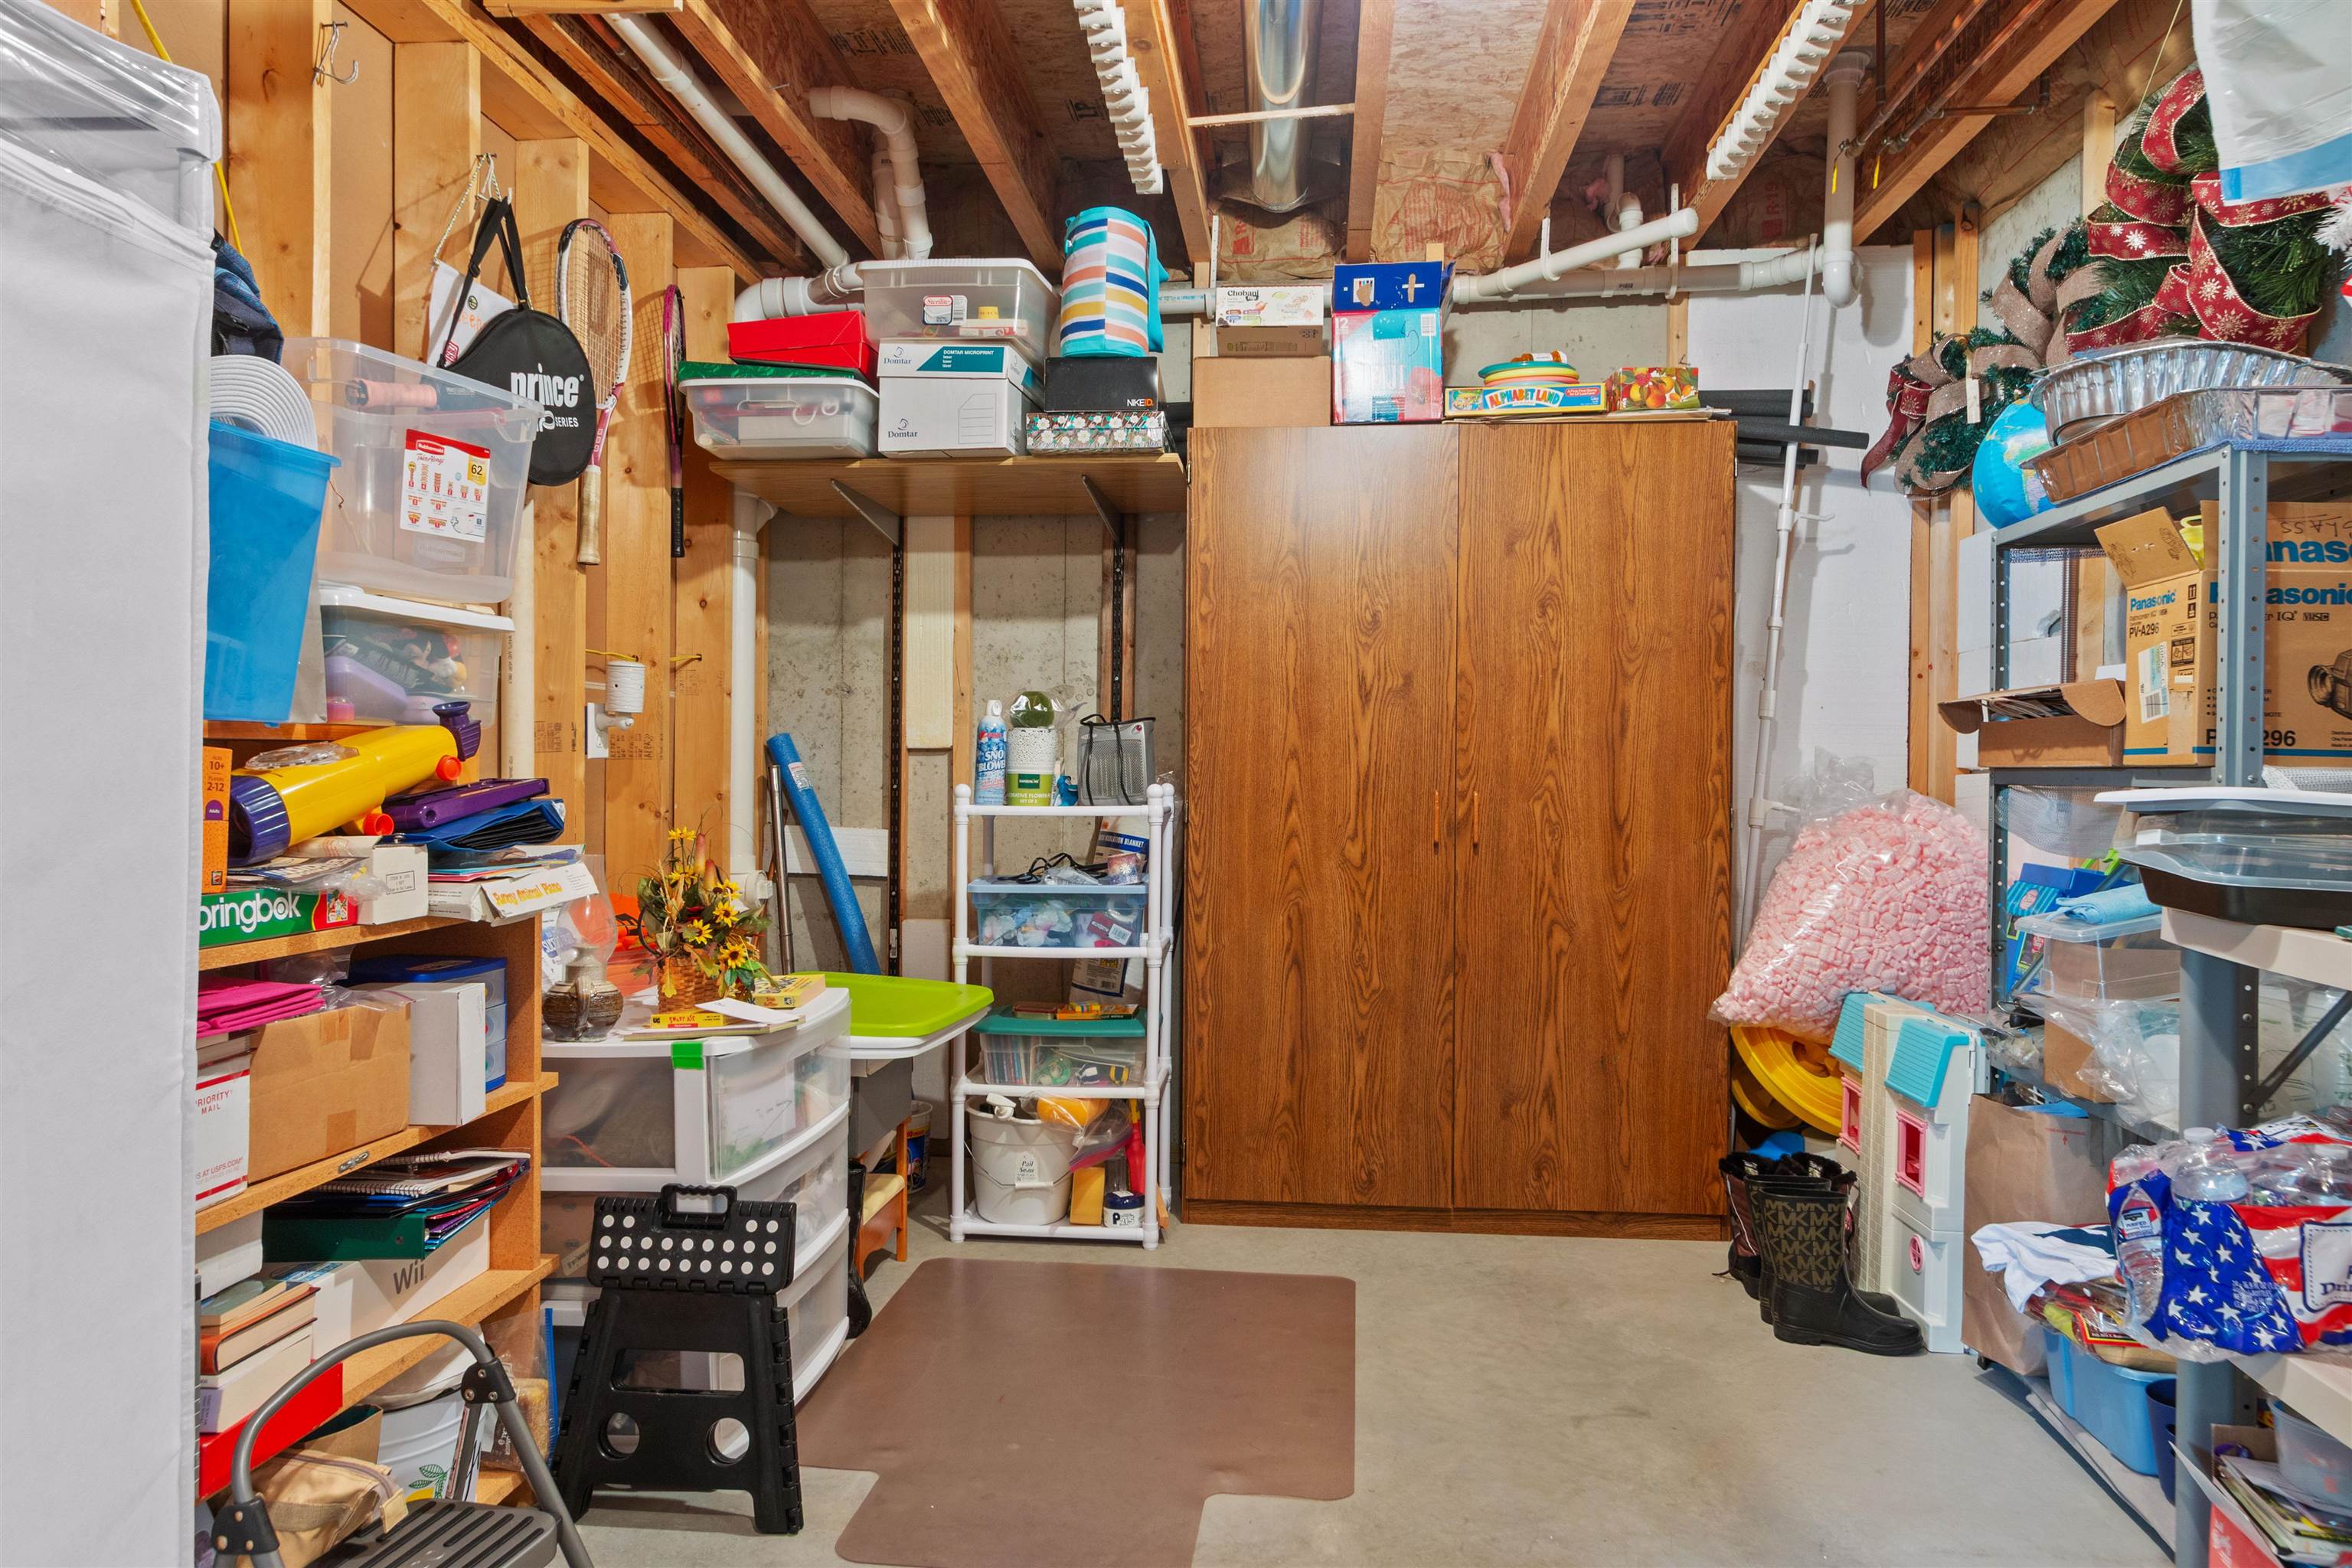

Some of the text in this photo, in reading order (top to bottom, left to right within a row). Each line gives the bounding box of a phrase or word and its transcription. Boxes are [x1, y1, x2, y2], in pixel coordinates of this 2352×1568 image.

[1334, 318, 1348, 329] 12
[511, 363, 580, 409] prince
[1488, 388, 1536, 408] ALPHABET
[1536, 389, 1561, 405] LAND
[554, 416, 579, 428] SERIES
[888, 430, 919, 439] Domtar
[471, 464, 483, 476] 62
[2130, 590, 2176, 612] Panasonic
[2129, 622, 2160, 639] PV-A296
[985, 750, 1004, 761] SNO
[209, 760, 225, 770] 10+
[978, 760, 1005, 772] BLOWE
[207, 781, 224, 792] 2-12
[1124, 838, 1145, 848] BLANKET
[196, 1090, 230, 1107] RIORITY
[201, 1104, 220, 1115] MAIL
[202, 1169, 209, 1178] AT
[211, 1157, 241, 1174] USPS.COM
[393, 1259, 426, 1294] Wii
